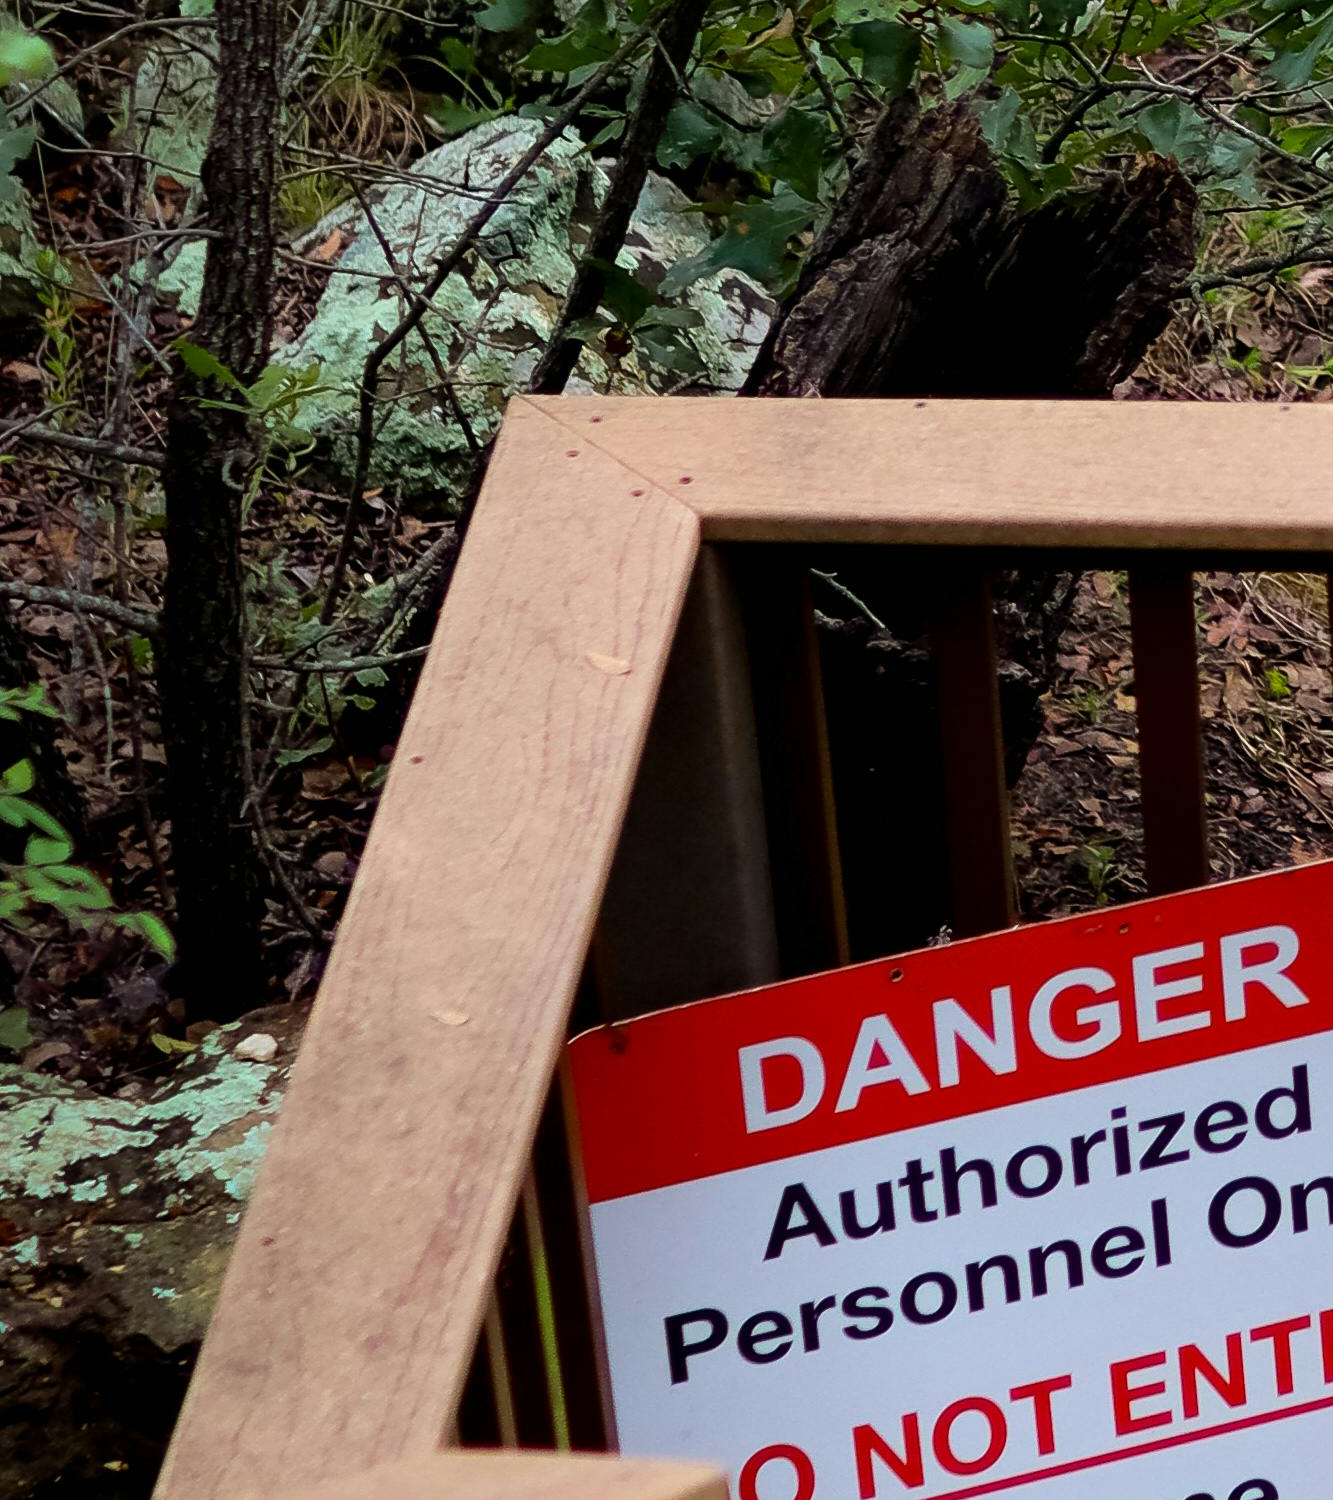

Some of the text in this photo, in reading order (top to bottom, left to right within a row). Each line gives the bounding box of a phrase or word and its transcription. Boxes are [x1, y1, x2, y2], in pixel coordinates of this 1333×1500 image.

[738, 925, 1310, 1134] DANGER
[763, 1064, 1312, 1262] Authorized
[663, 1198, 1171, 1386] Personnel
[853, 1375, 1072, 1500] NOT
